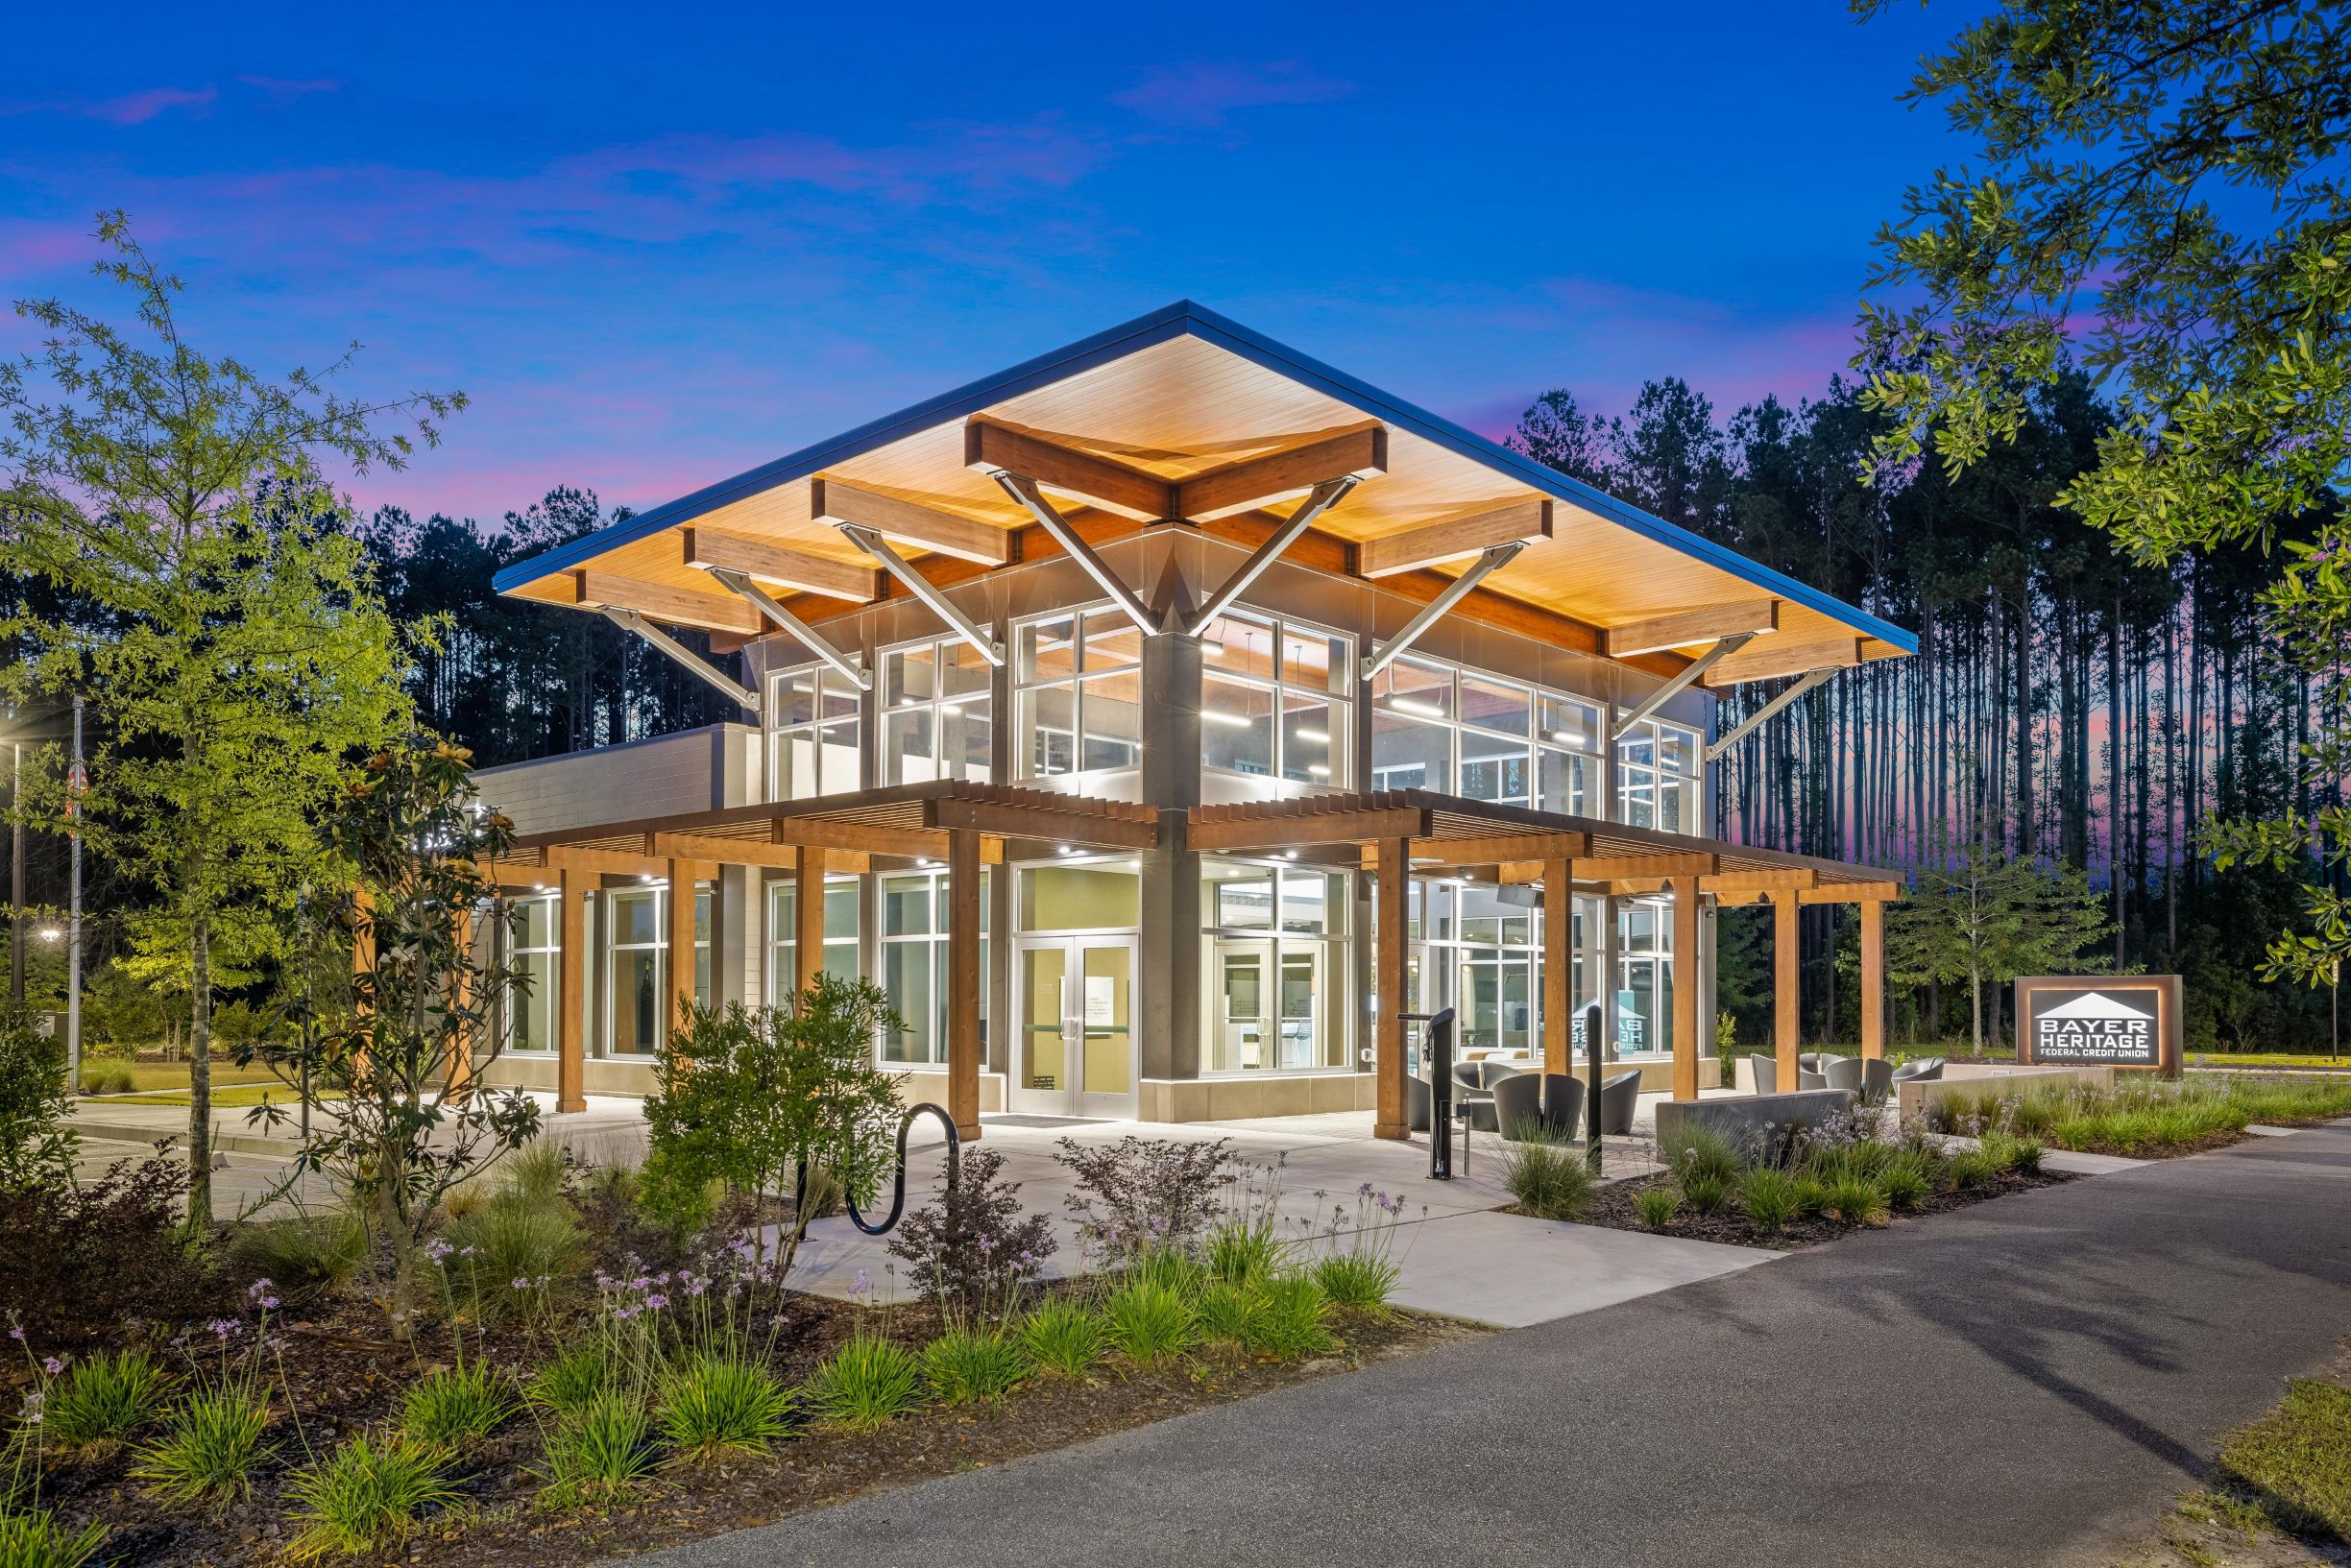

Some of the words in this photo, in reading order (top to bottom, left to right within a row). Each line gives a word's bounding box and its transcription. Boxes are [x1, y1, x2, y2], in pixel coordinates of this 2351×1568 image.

[2041, 1020, 2148, 1034] BAYER
[2040, 1034, 2148, 1049] HERITAGE
[2082, 1049, 2117, 1057] CREDIT
[2118, 1049, 2149, 1058] UNION
